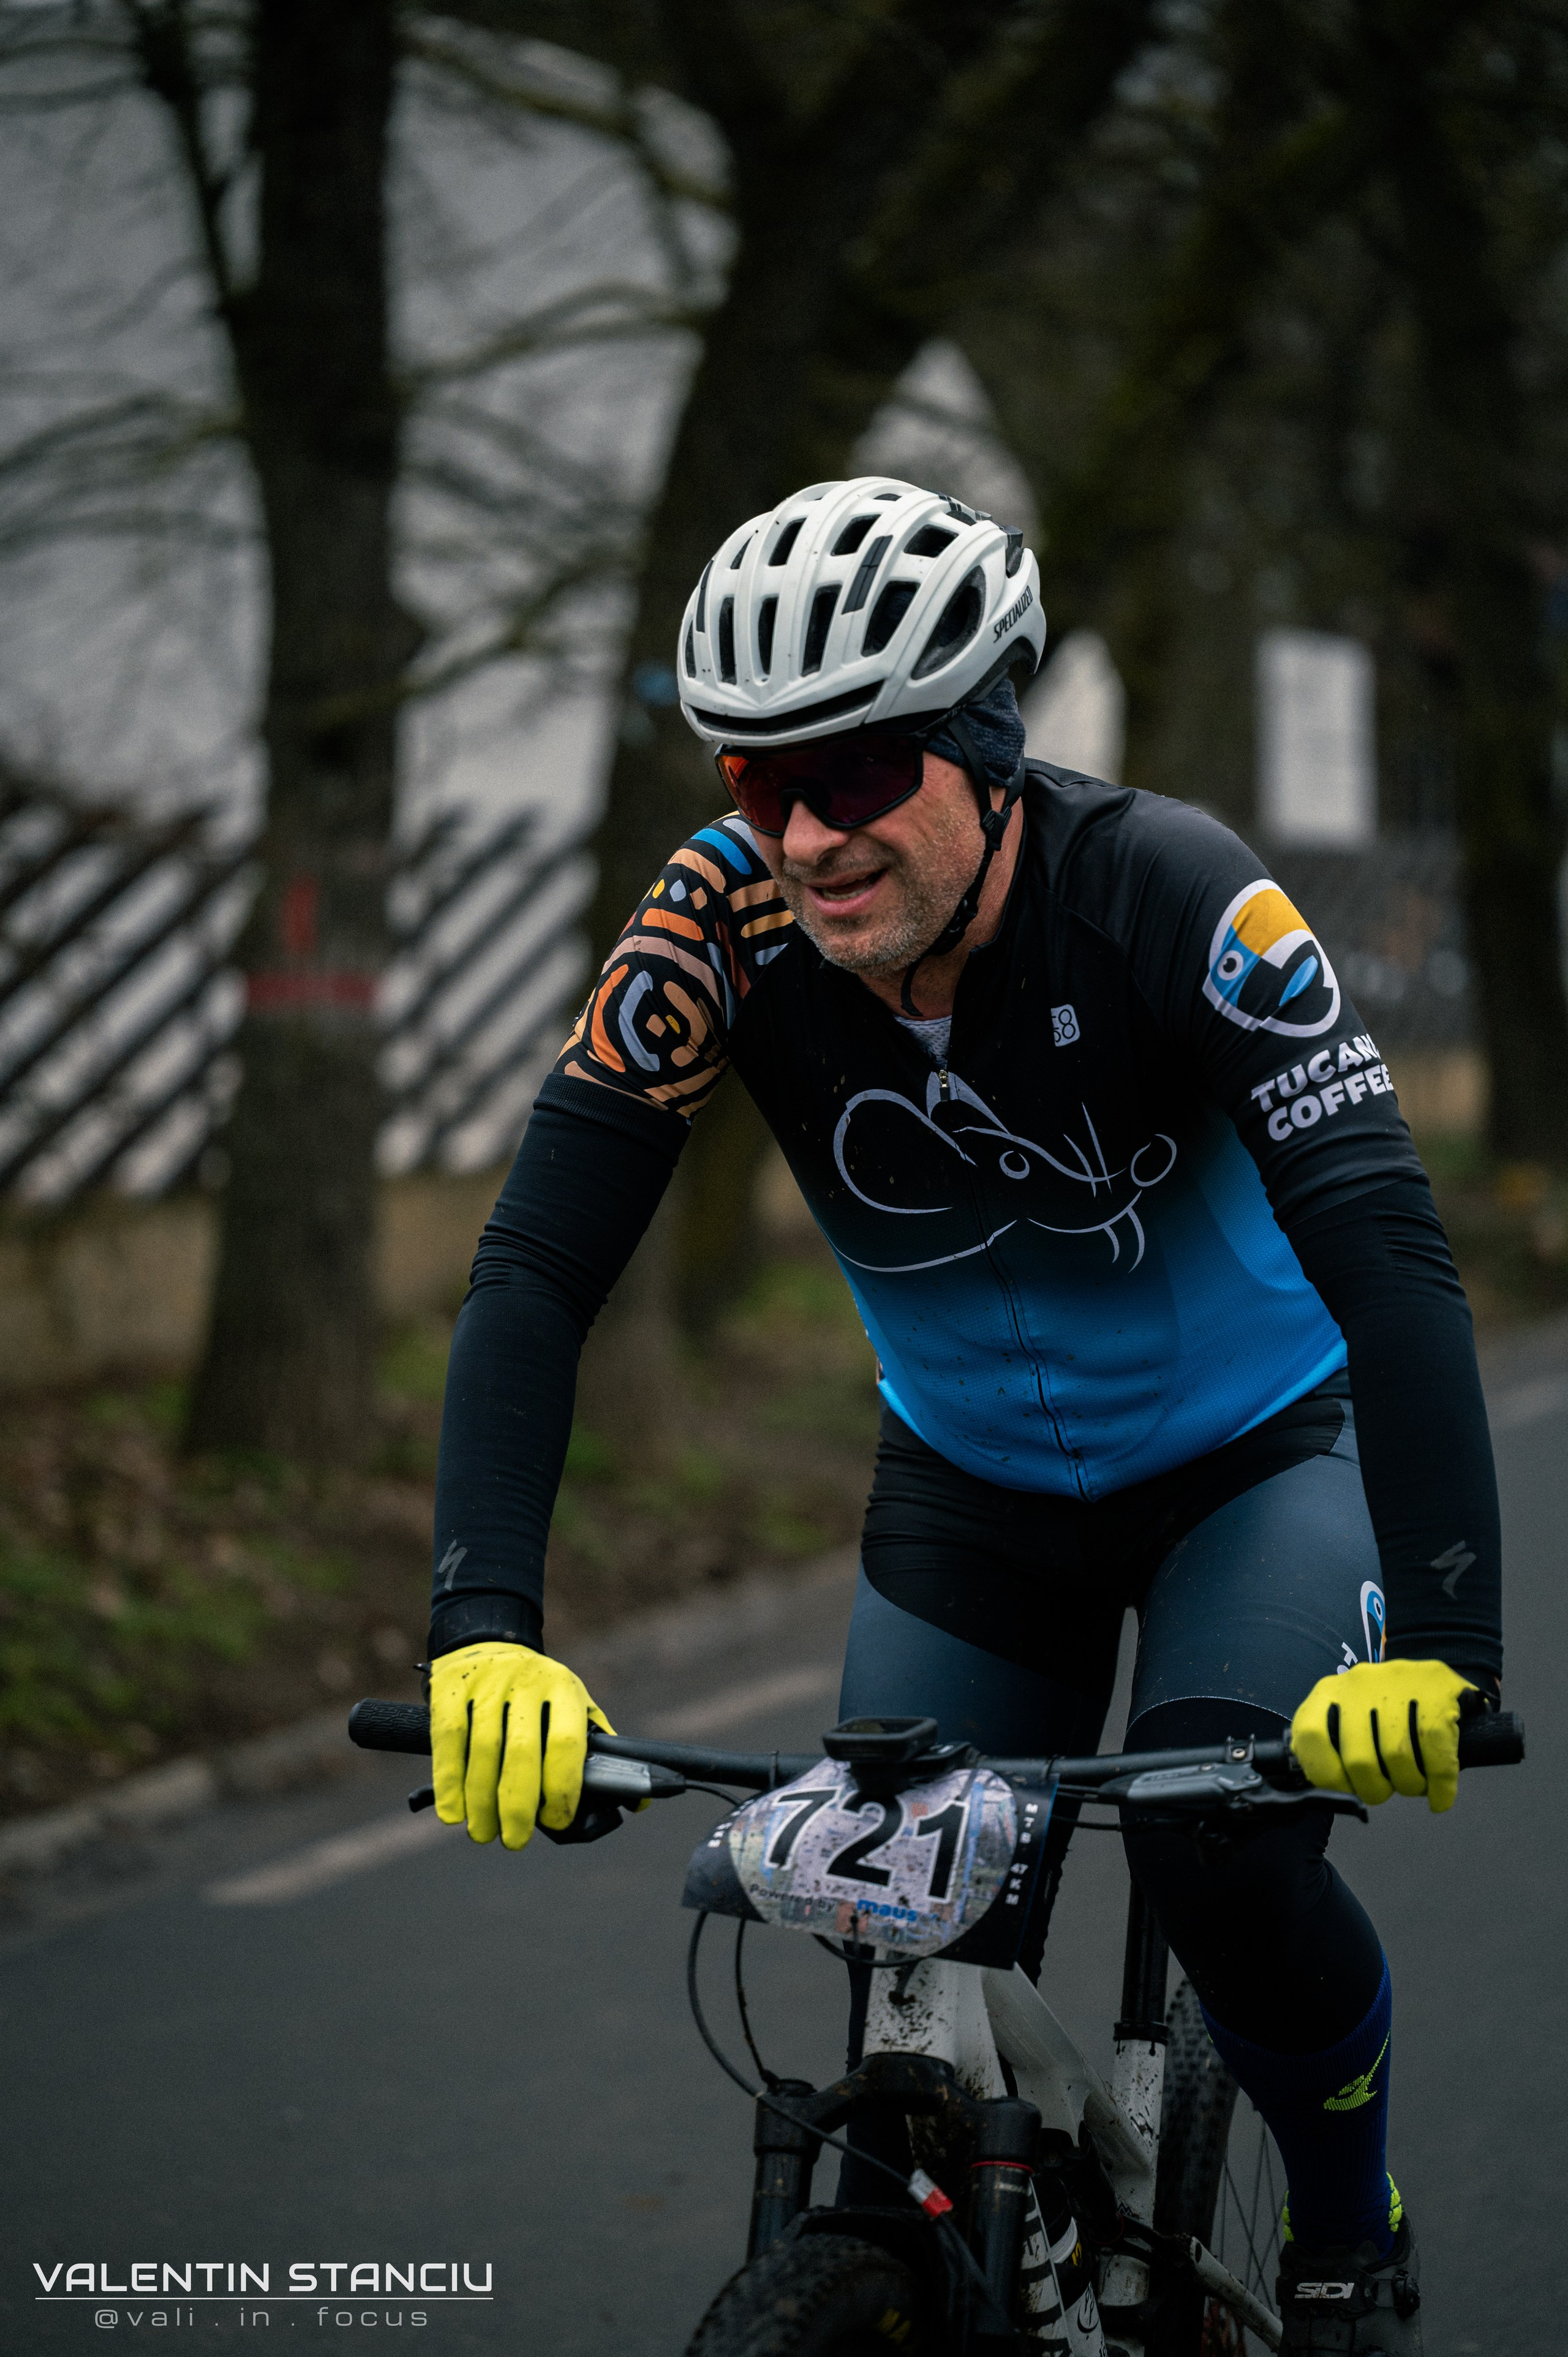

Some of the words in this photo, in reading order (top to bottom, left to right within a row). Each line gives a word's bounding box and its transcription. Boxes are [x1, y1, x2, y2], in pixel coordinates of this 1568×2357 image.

[993, 584, 1033, 643] SPECIALIZED
[1251, 1033, 1381, 1112] TUCAN
[764, 1785, 970, 1904] 721
[856, 1899, 918, 1922] maus
